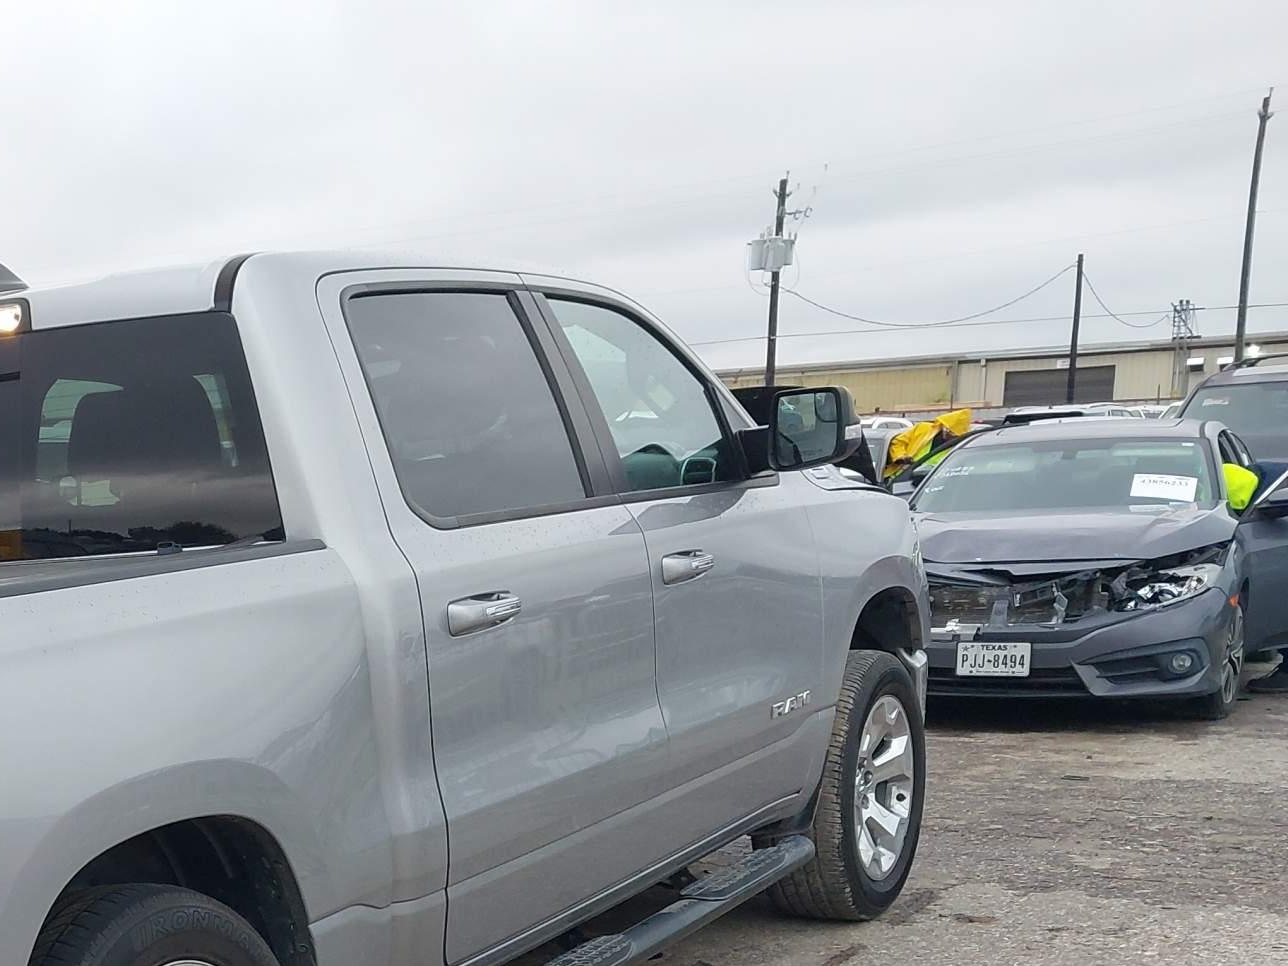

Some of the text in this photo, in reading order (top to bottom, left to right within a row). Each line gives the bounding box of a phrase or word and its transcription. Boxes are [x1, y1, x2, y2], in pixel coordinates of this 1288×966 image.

[980, 644, 1009, 652] TEXAS
[960, 653, 1026, 670] PJJ-8494
[770, 689, 812, 720] RAM
[134, 909, 262, 960] IRONMA
